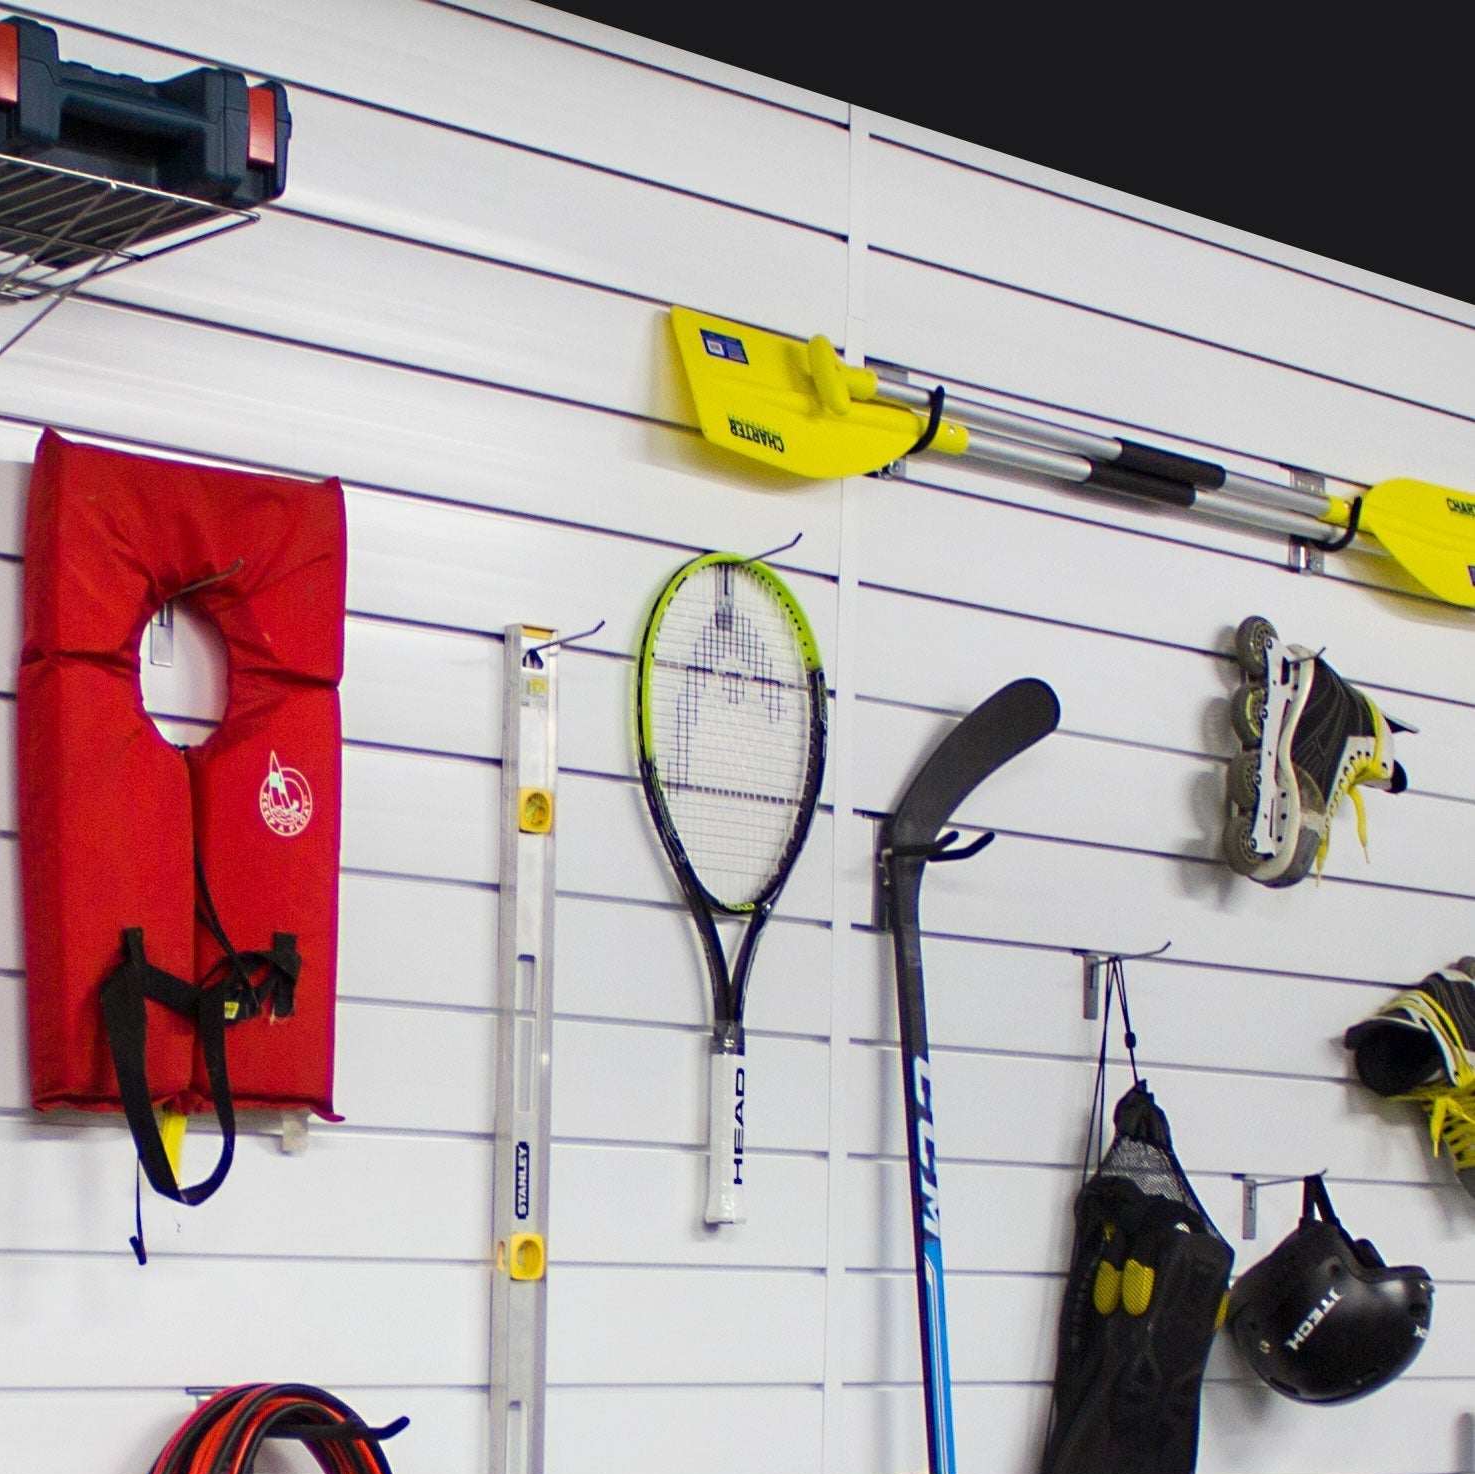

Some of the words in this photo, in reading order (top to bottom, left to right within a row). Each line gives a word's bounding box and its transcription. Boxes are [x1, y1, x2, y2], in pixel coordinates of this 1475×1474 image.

[728, 417, 785, 453] CHARTER
[733, 1067, 745, 1185] HEAD
[912, 1055, 941, 1239] CCM
[516, 1146, 528, 1216] STANLEY
